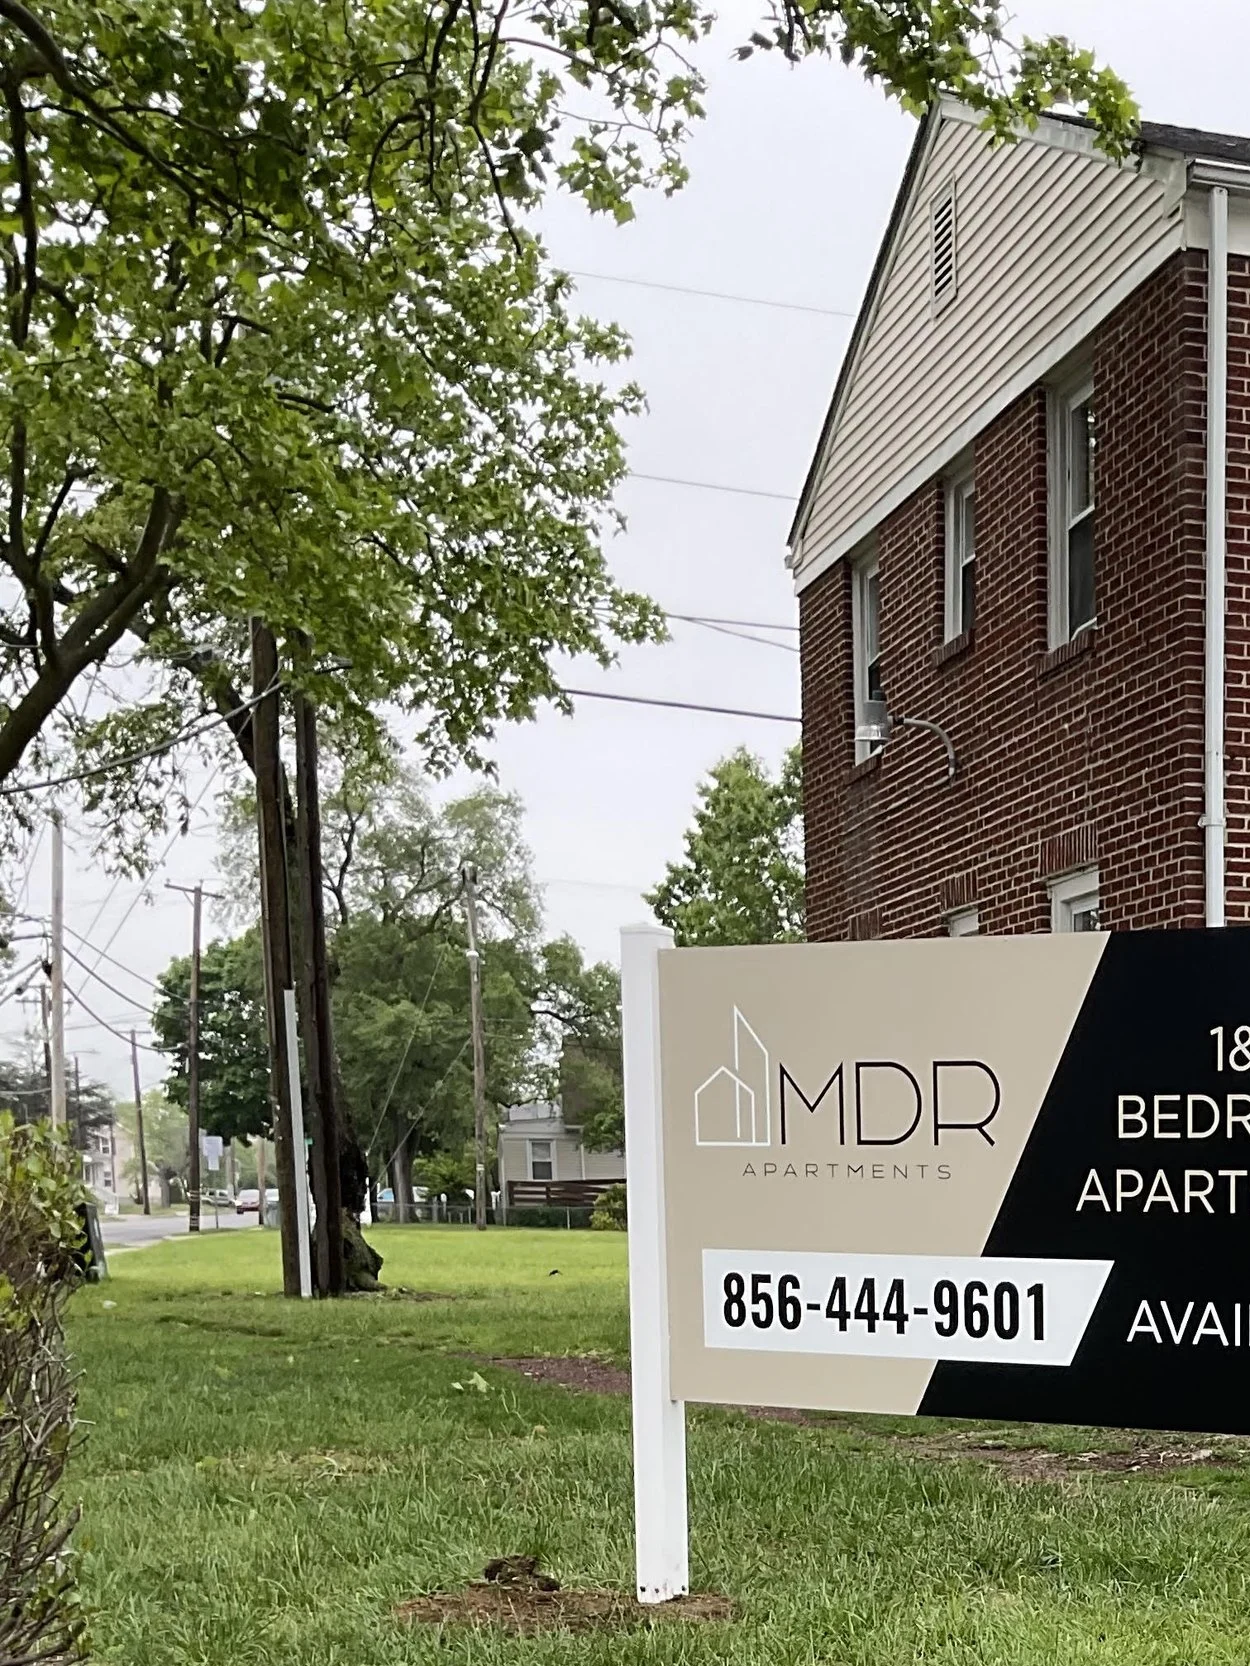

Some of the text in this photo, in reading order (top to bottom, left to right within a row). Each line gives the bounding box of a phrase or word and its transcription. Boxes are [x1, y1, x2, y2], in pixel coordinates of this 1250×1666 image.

[779, 1060, 1001, 1147] MDR
[742, 1162, 952, 1180] APARTMENTS
[723, 1272, 1044, 1341] 856-444-9601
